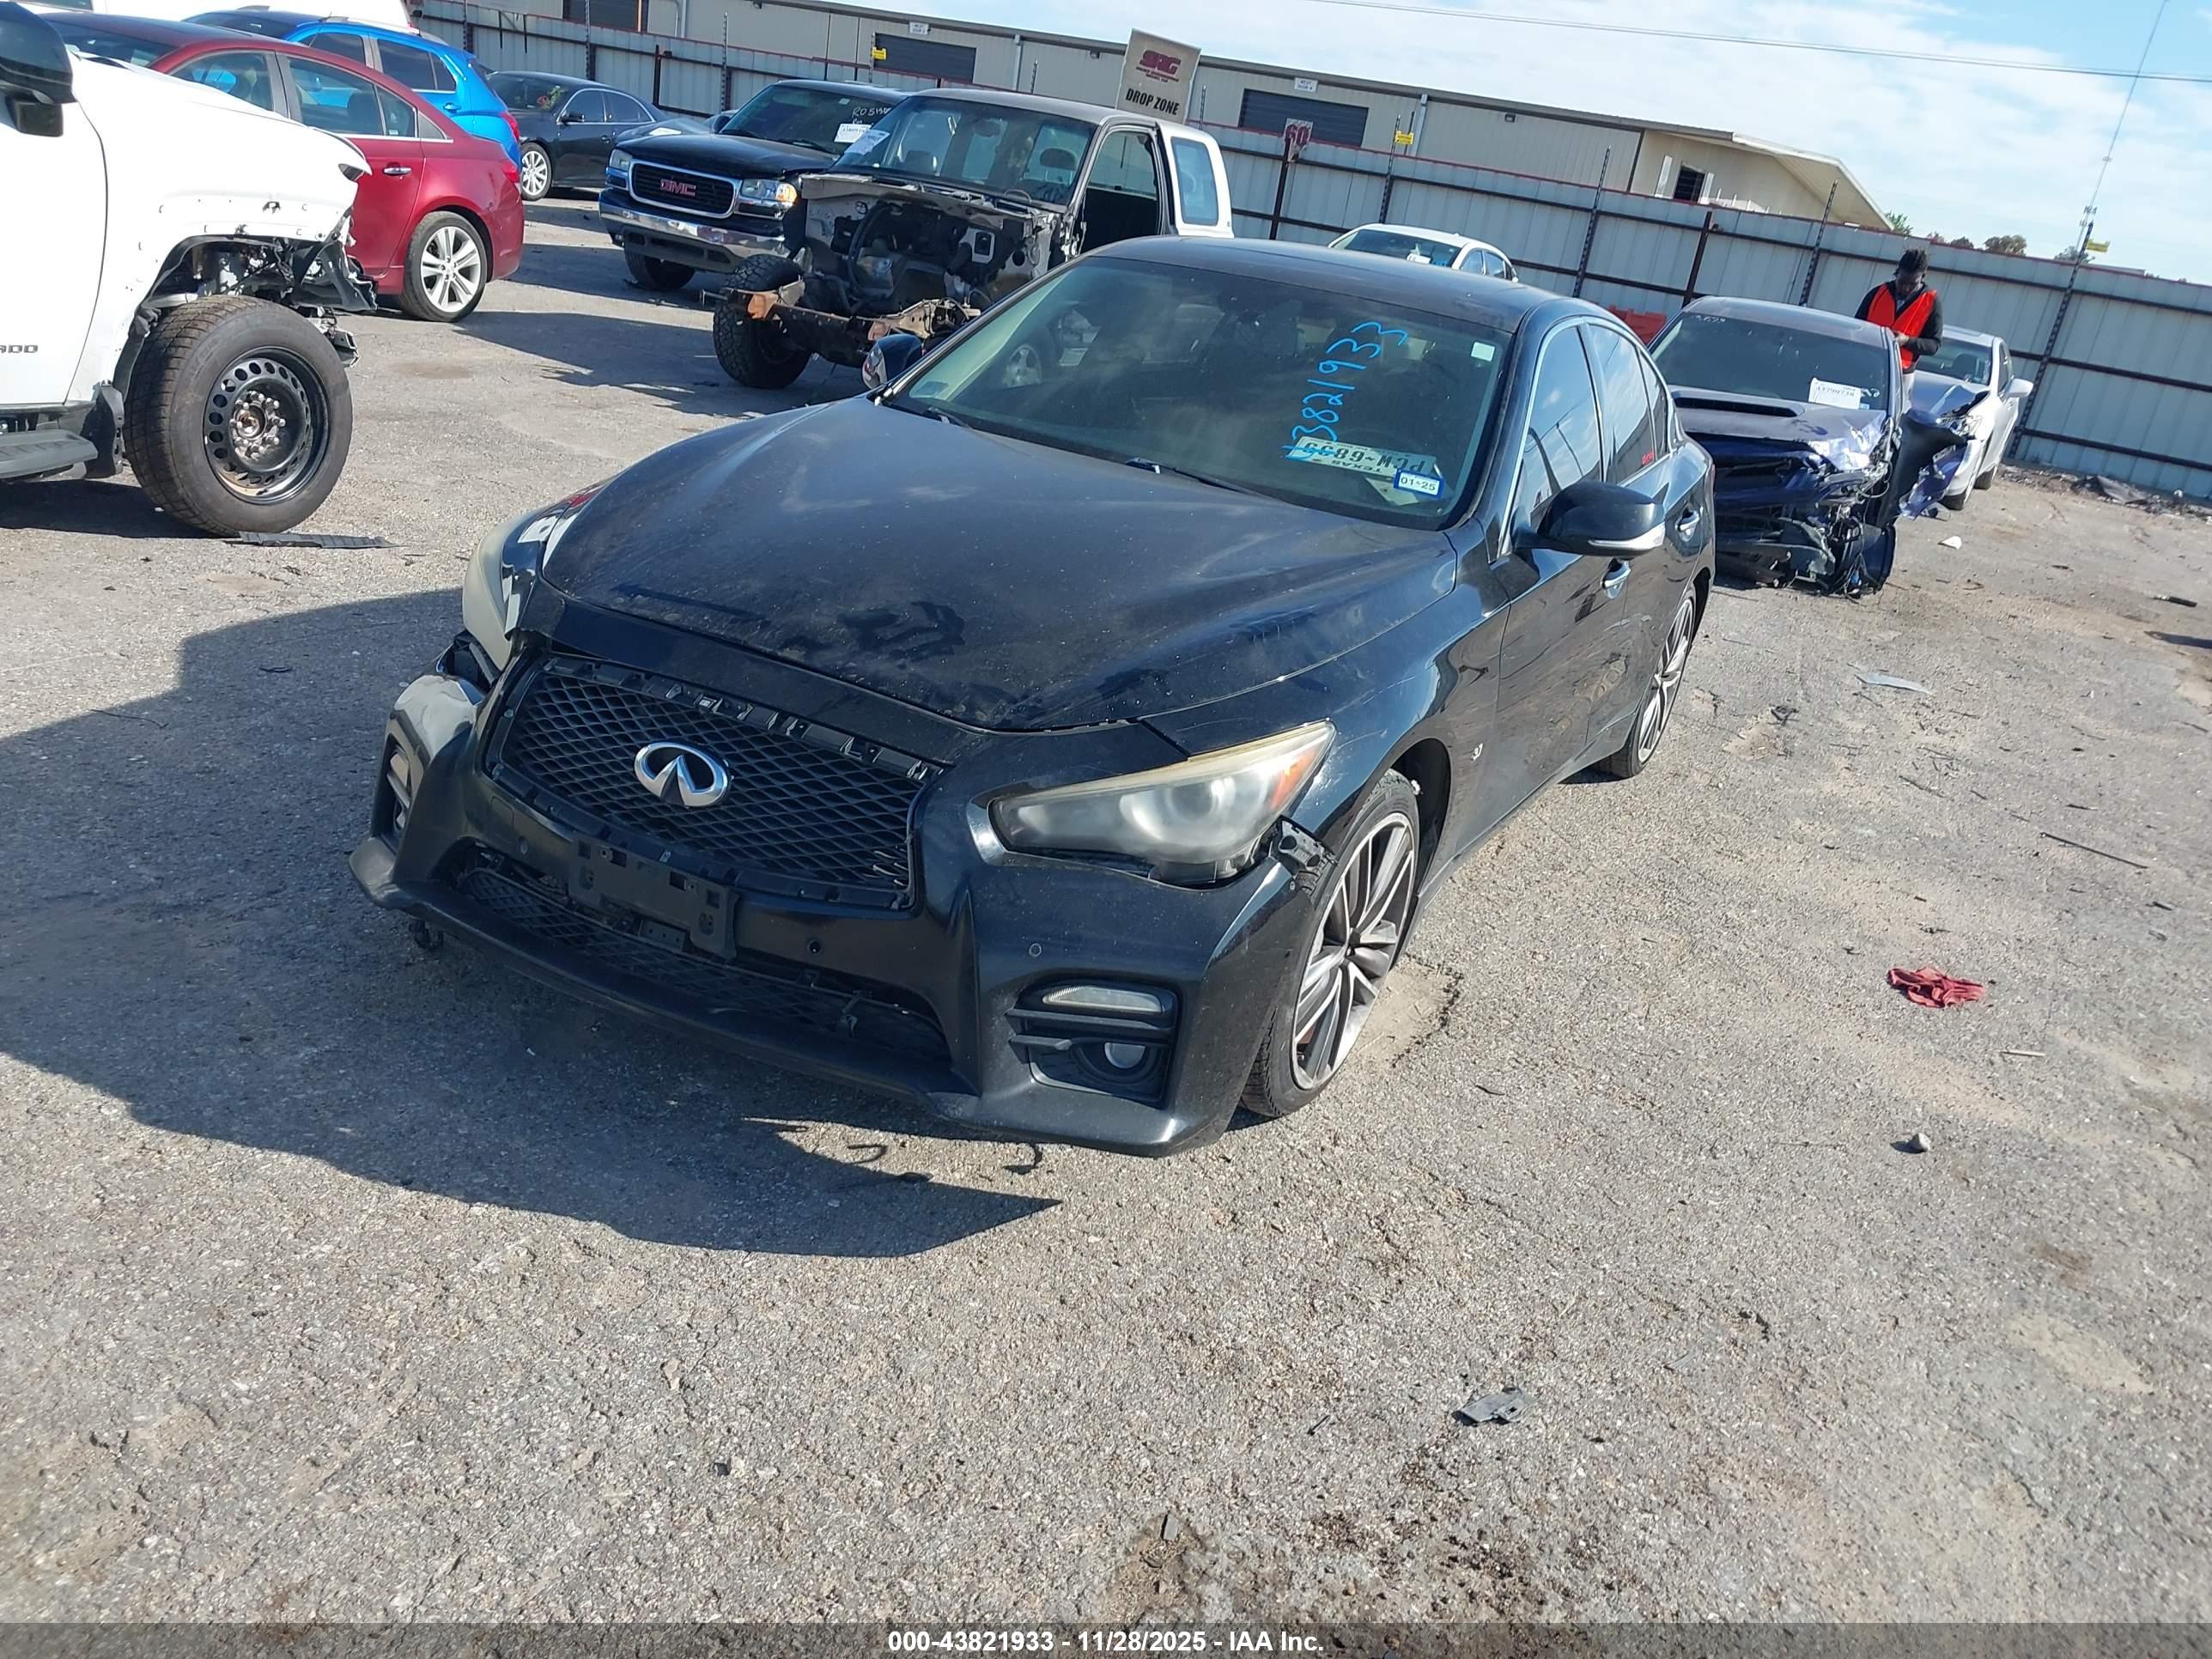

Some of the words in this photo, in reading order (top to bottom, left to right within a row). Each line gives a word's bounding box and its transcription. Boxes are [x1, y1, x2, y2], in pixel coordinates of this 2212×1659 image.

[1125, 88, 1154, 106] DROP
[1152, 96, 1180, 115] ZONE
[1285, 125, 1310, 146] 60
[660, 179, 696, 197] GMC
[1331, 459, 1382, 473] TEXAS
